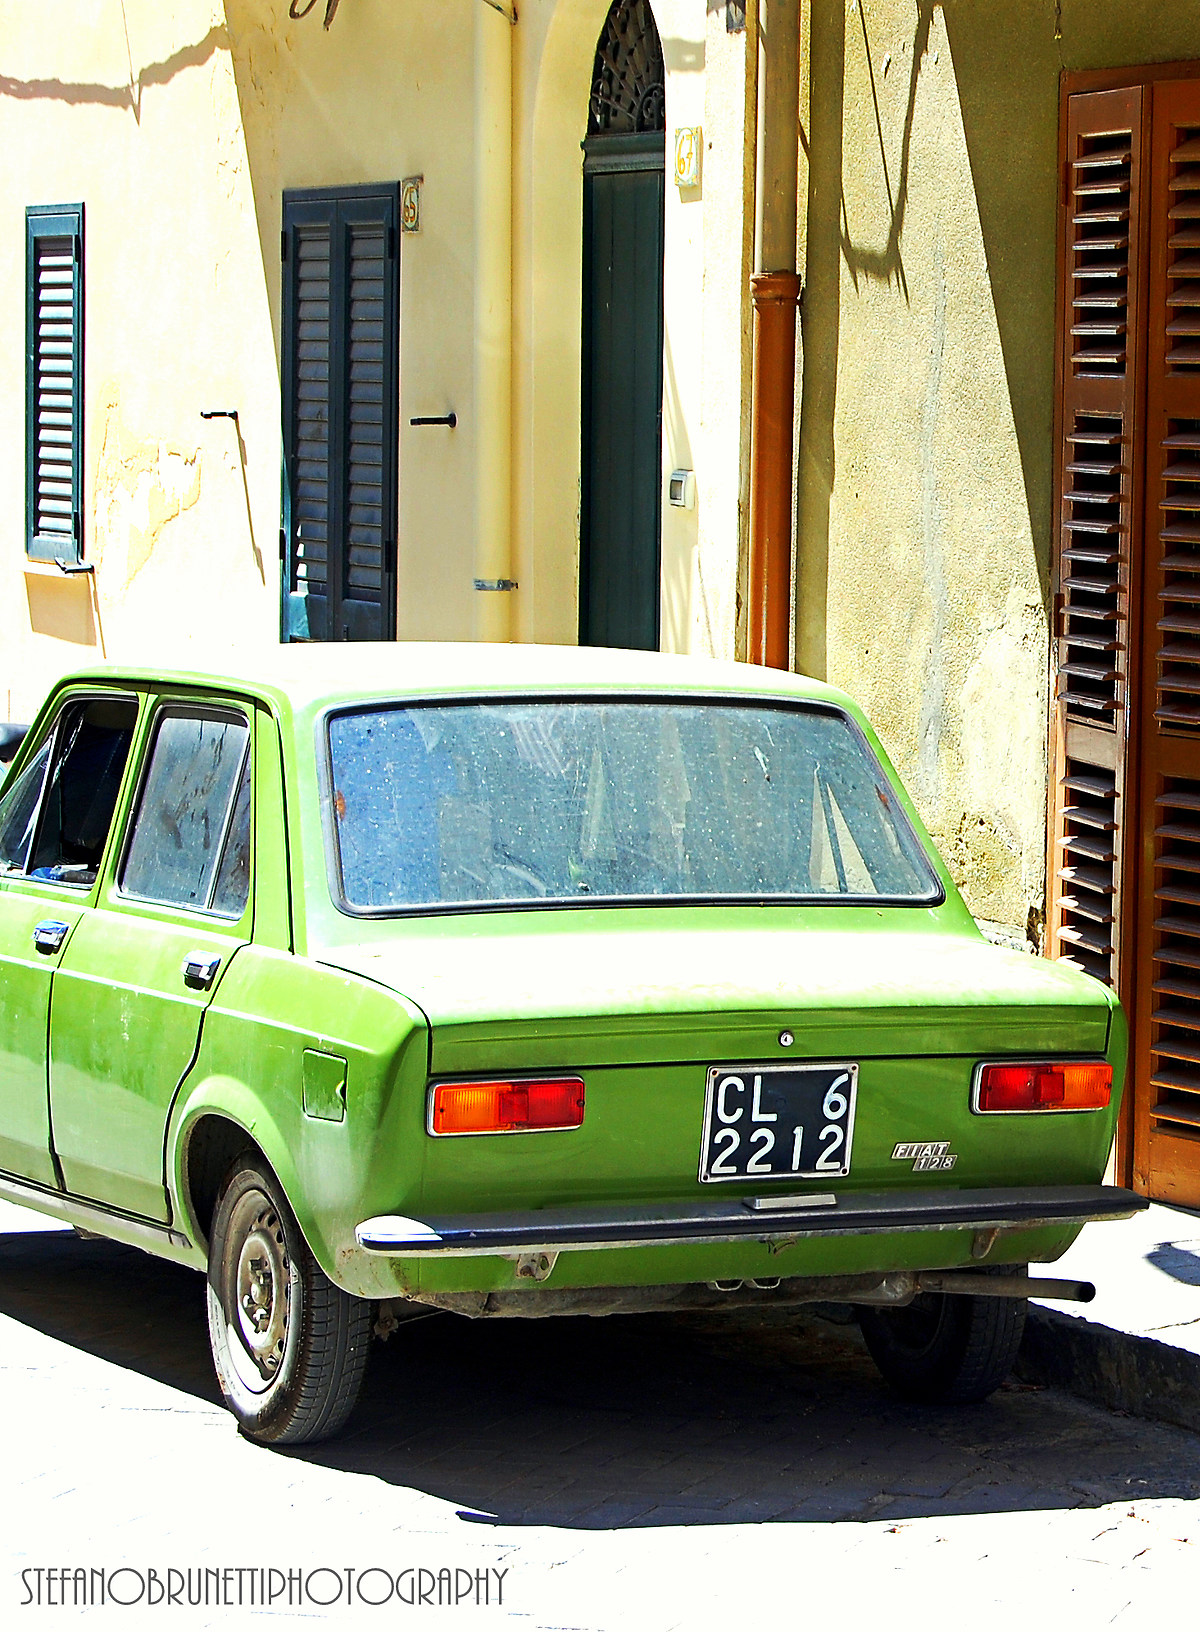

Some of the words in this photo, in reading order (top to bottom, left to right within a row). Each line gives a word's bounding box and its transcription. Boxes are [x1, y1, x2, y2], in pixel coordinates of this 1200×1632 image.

[677, 133, 694, 175] 67
[403, 186, 417, 223] 65
[716, 1075, 778, 1125] CL
[822, 1072, 849, 1121] 6
[710, 1123, 844, 1174] 2212
[895, 1143, 949, 1158] FIAT
[917, 1156, 955, 1169] 128
